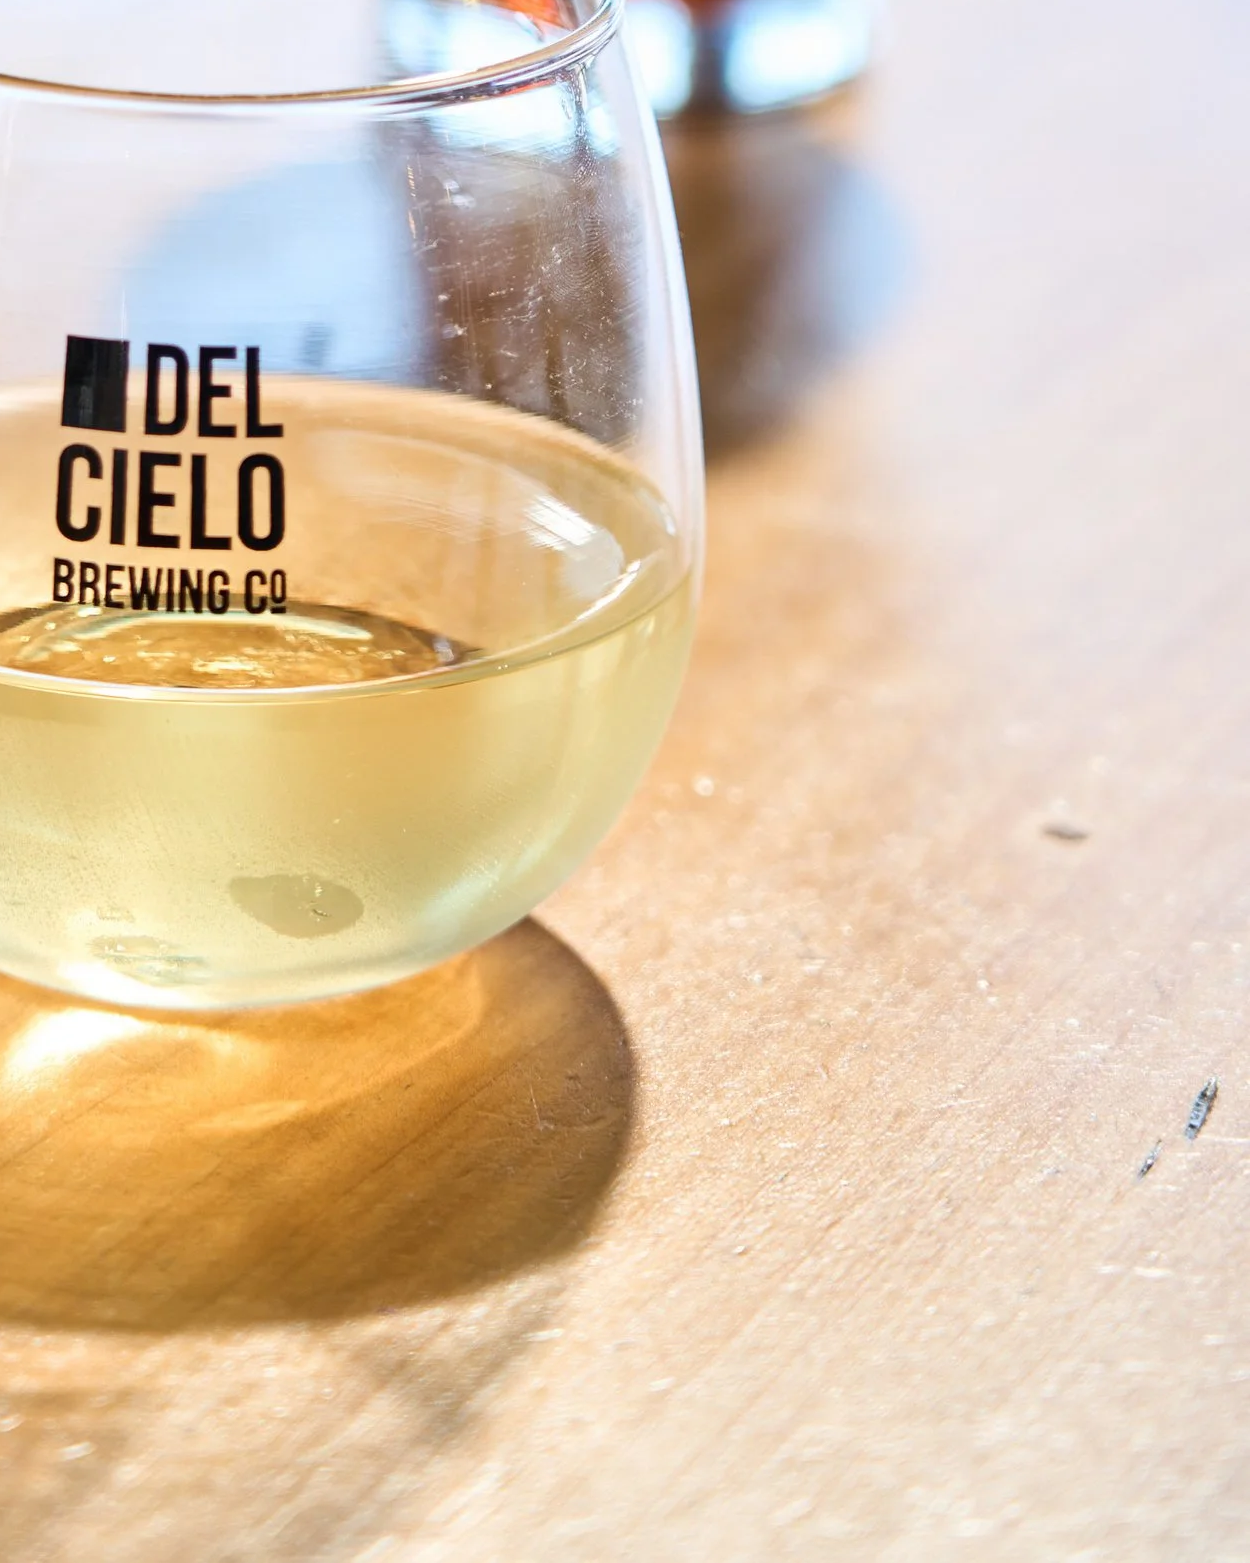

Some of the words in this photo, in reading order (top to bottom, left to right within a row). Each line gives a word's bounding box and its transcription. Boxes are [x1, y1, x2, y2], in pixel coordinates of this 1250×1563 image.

[144, 343, 284, 438] DEL
[56, 443, 285, 551] CIELO
[53, 557, 230, 615] BREWING
